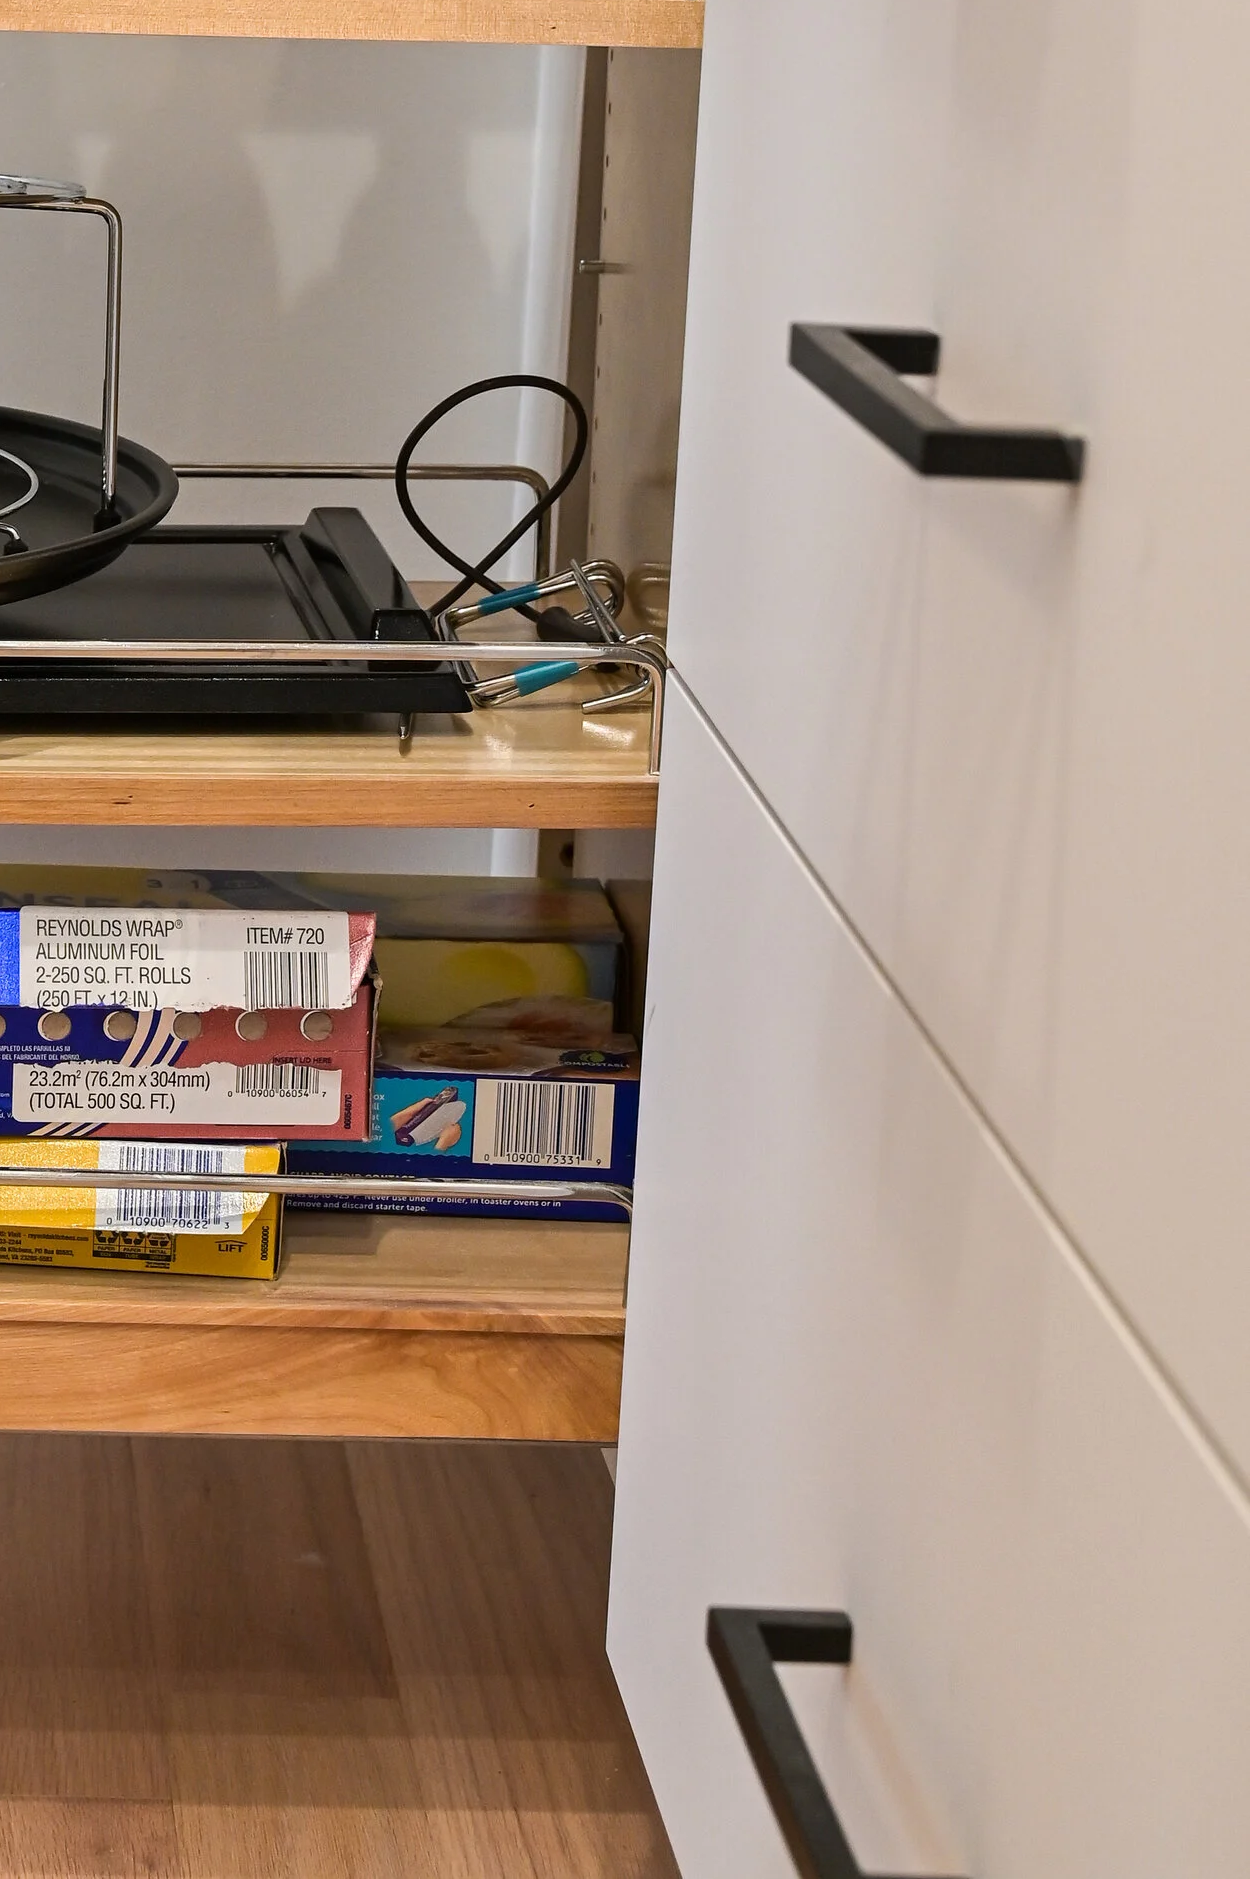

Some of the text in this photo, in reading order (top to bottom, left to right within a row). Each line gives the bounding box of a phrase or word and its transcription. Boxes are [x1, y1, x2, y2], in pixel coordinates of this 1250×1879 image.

[35, 918, 123, 938] REYNOLDS
[246, 927, 325, 946] ITEM# 720
[35, 942, 165, 961] ALUMINUM FOIL
[35, 966, 192, 986] 2-250 SQ. FT. ROLLS
[35, 990, 72, 1010] (250
[131, 991, 159, 1010] IN.)
[84, 1070, 135, 1091] (76.2m
[137, 1074, 147, 1088] x
[149, 1070, 211, 1092] 304mm)
[28, 1092, 176, 1114] (TOTAL 500 SQ. FT.)
[247, 1088, 310, 1099] 10900 06054
[505, 1151, 581, 1166] 10900 75331
[286, 1200, 428, 1213] Remove and discard starter tape.
[129, 1217, 208, 1230] 10900 70622
[218, 1243, 244, 1253] LIFT
